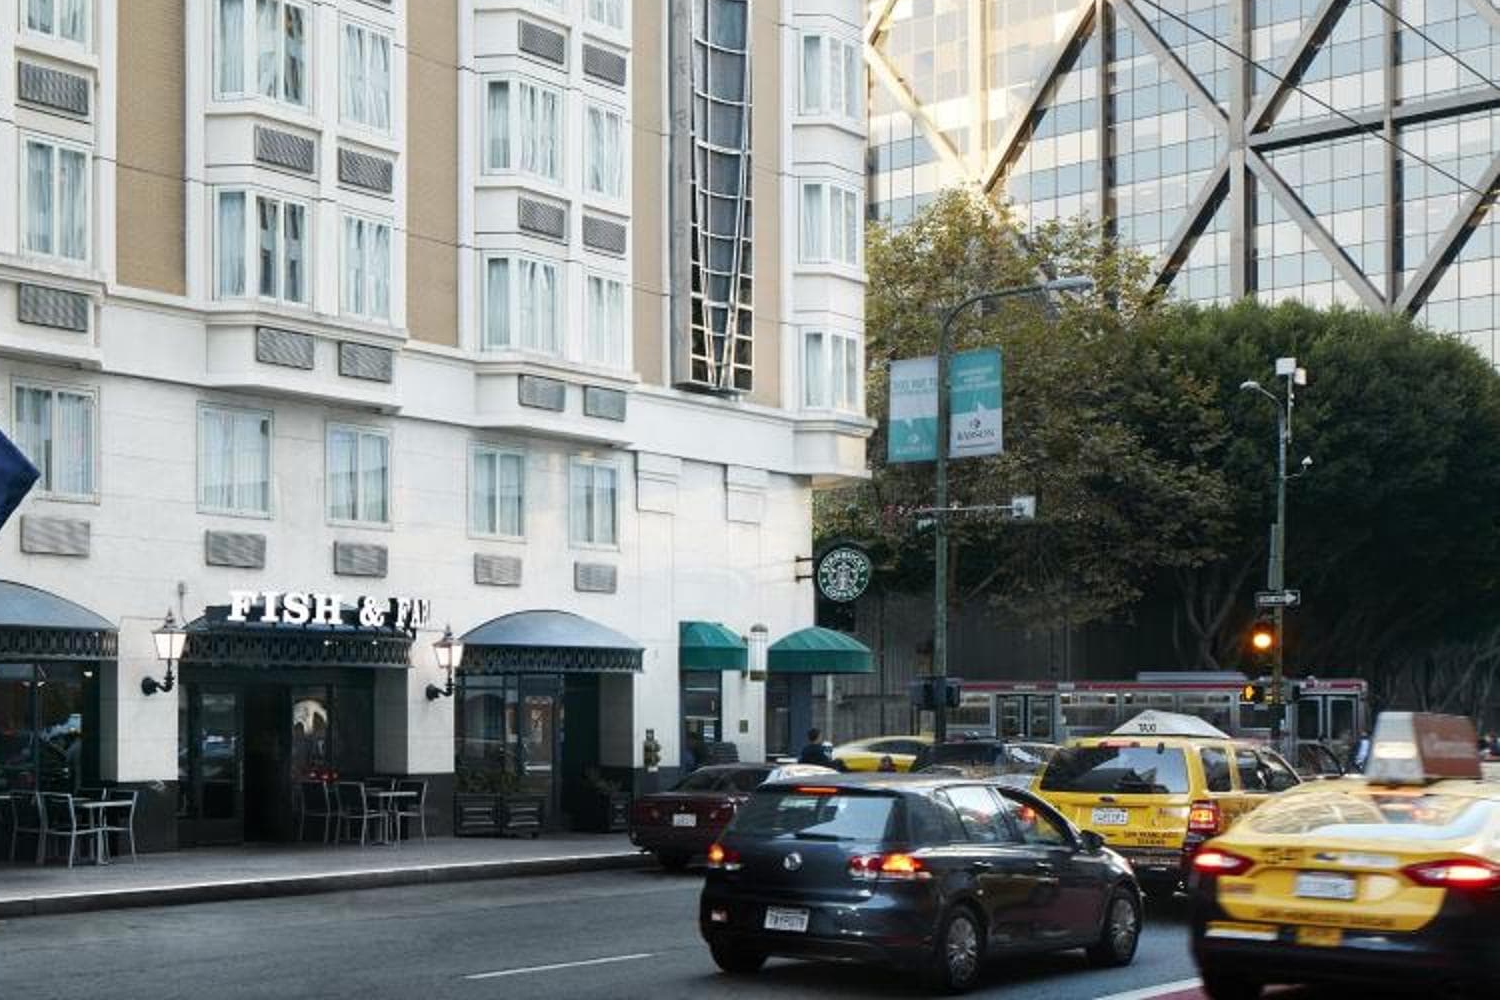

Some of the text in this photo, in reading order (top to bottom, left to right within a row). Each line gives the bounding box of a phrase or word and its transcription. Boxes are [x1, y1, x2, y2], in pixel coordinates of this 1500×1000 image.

[228, 590, 344, 625] FISH
[359, 595, 391, 627] &
[1138, 723, 1157, 733] TAXI
